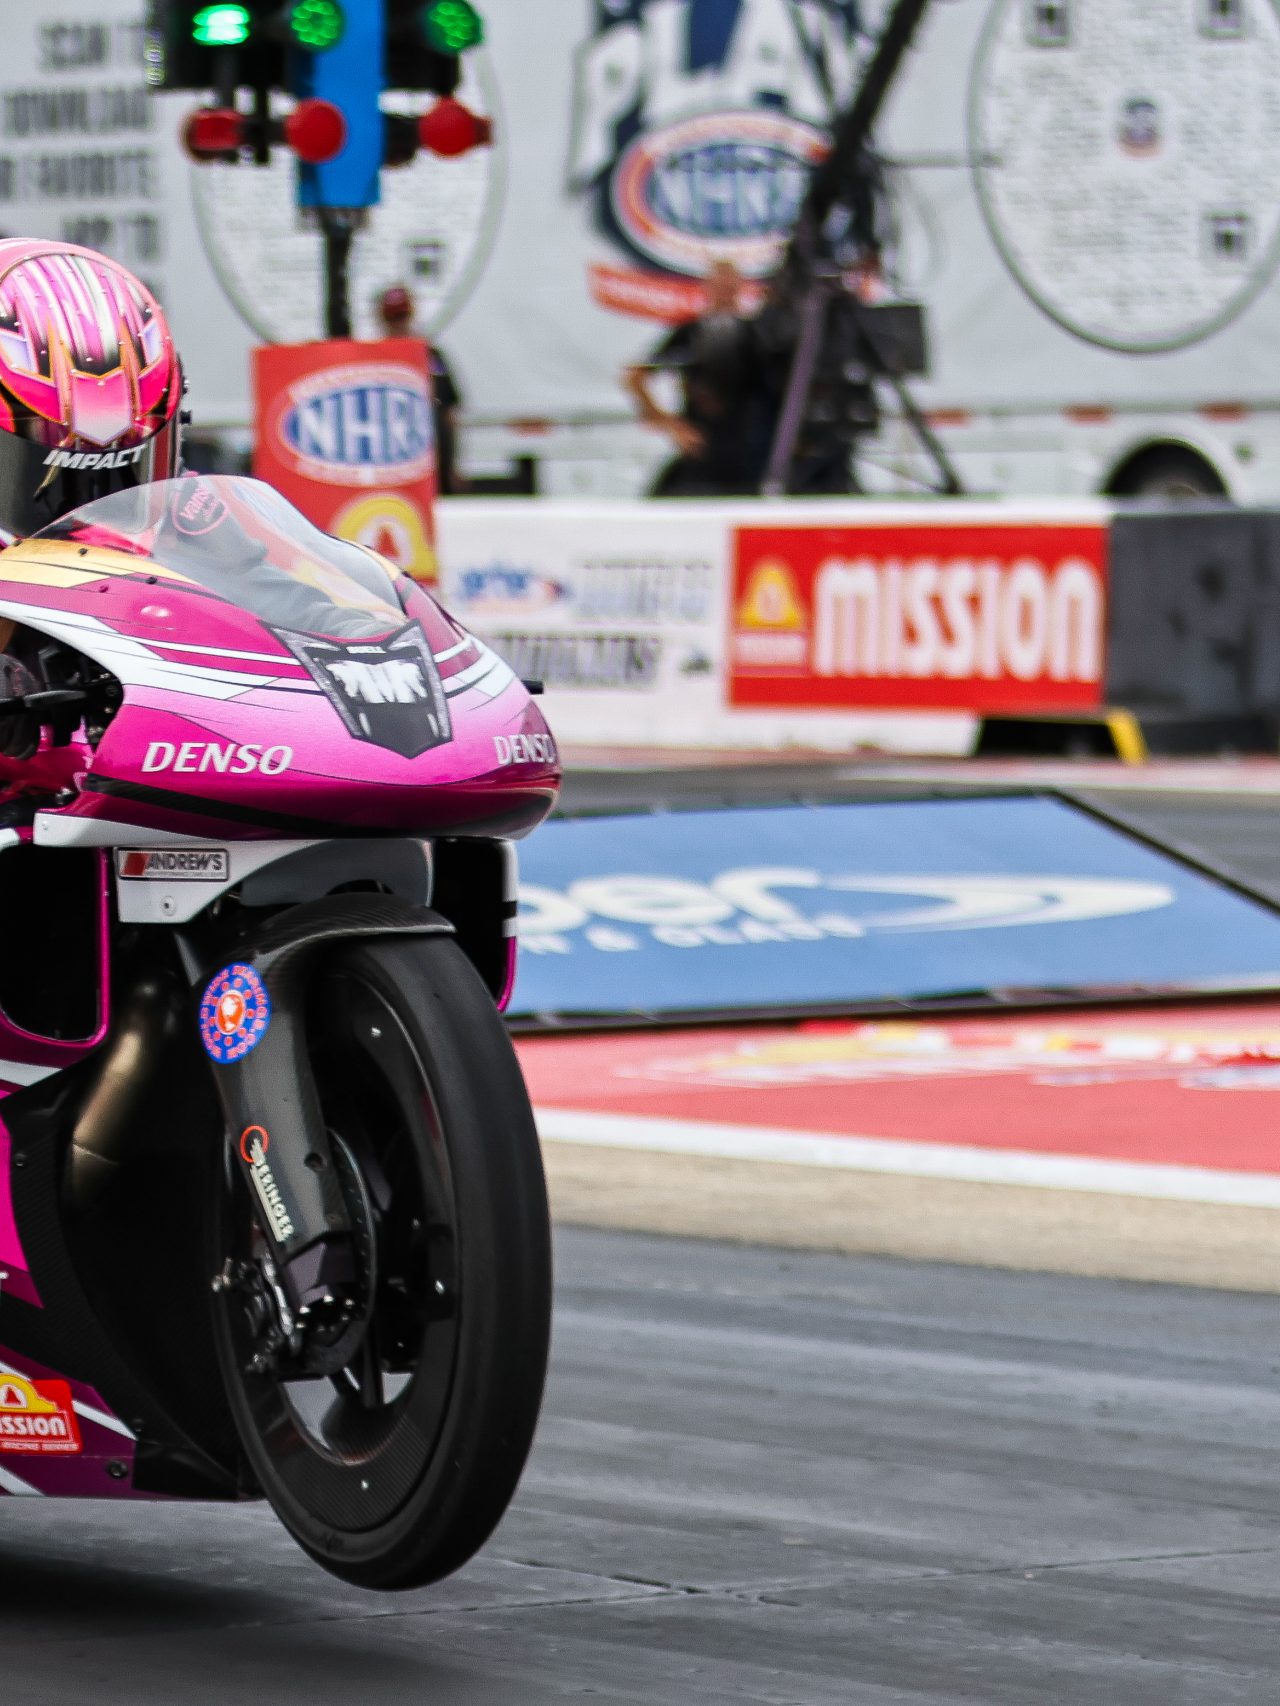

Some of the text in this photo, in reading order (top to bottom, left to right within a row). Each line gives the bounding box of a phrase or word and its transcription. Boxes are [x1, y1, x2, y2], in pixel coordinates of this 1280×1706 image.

[43, 445, 148, 471] IMPACT
[813, 555, 1104, 683] MISSION
[141, 741, 294, 776] DENSO
[492, 732, 556, 766] DENSO
